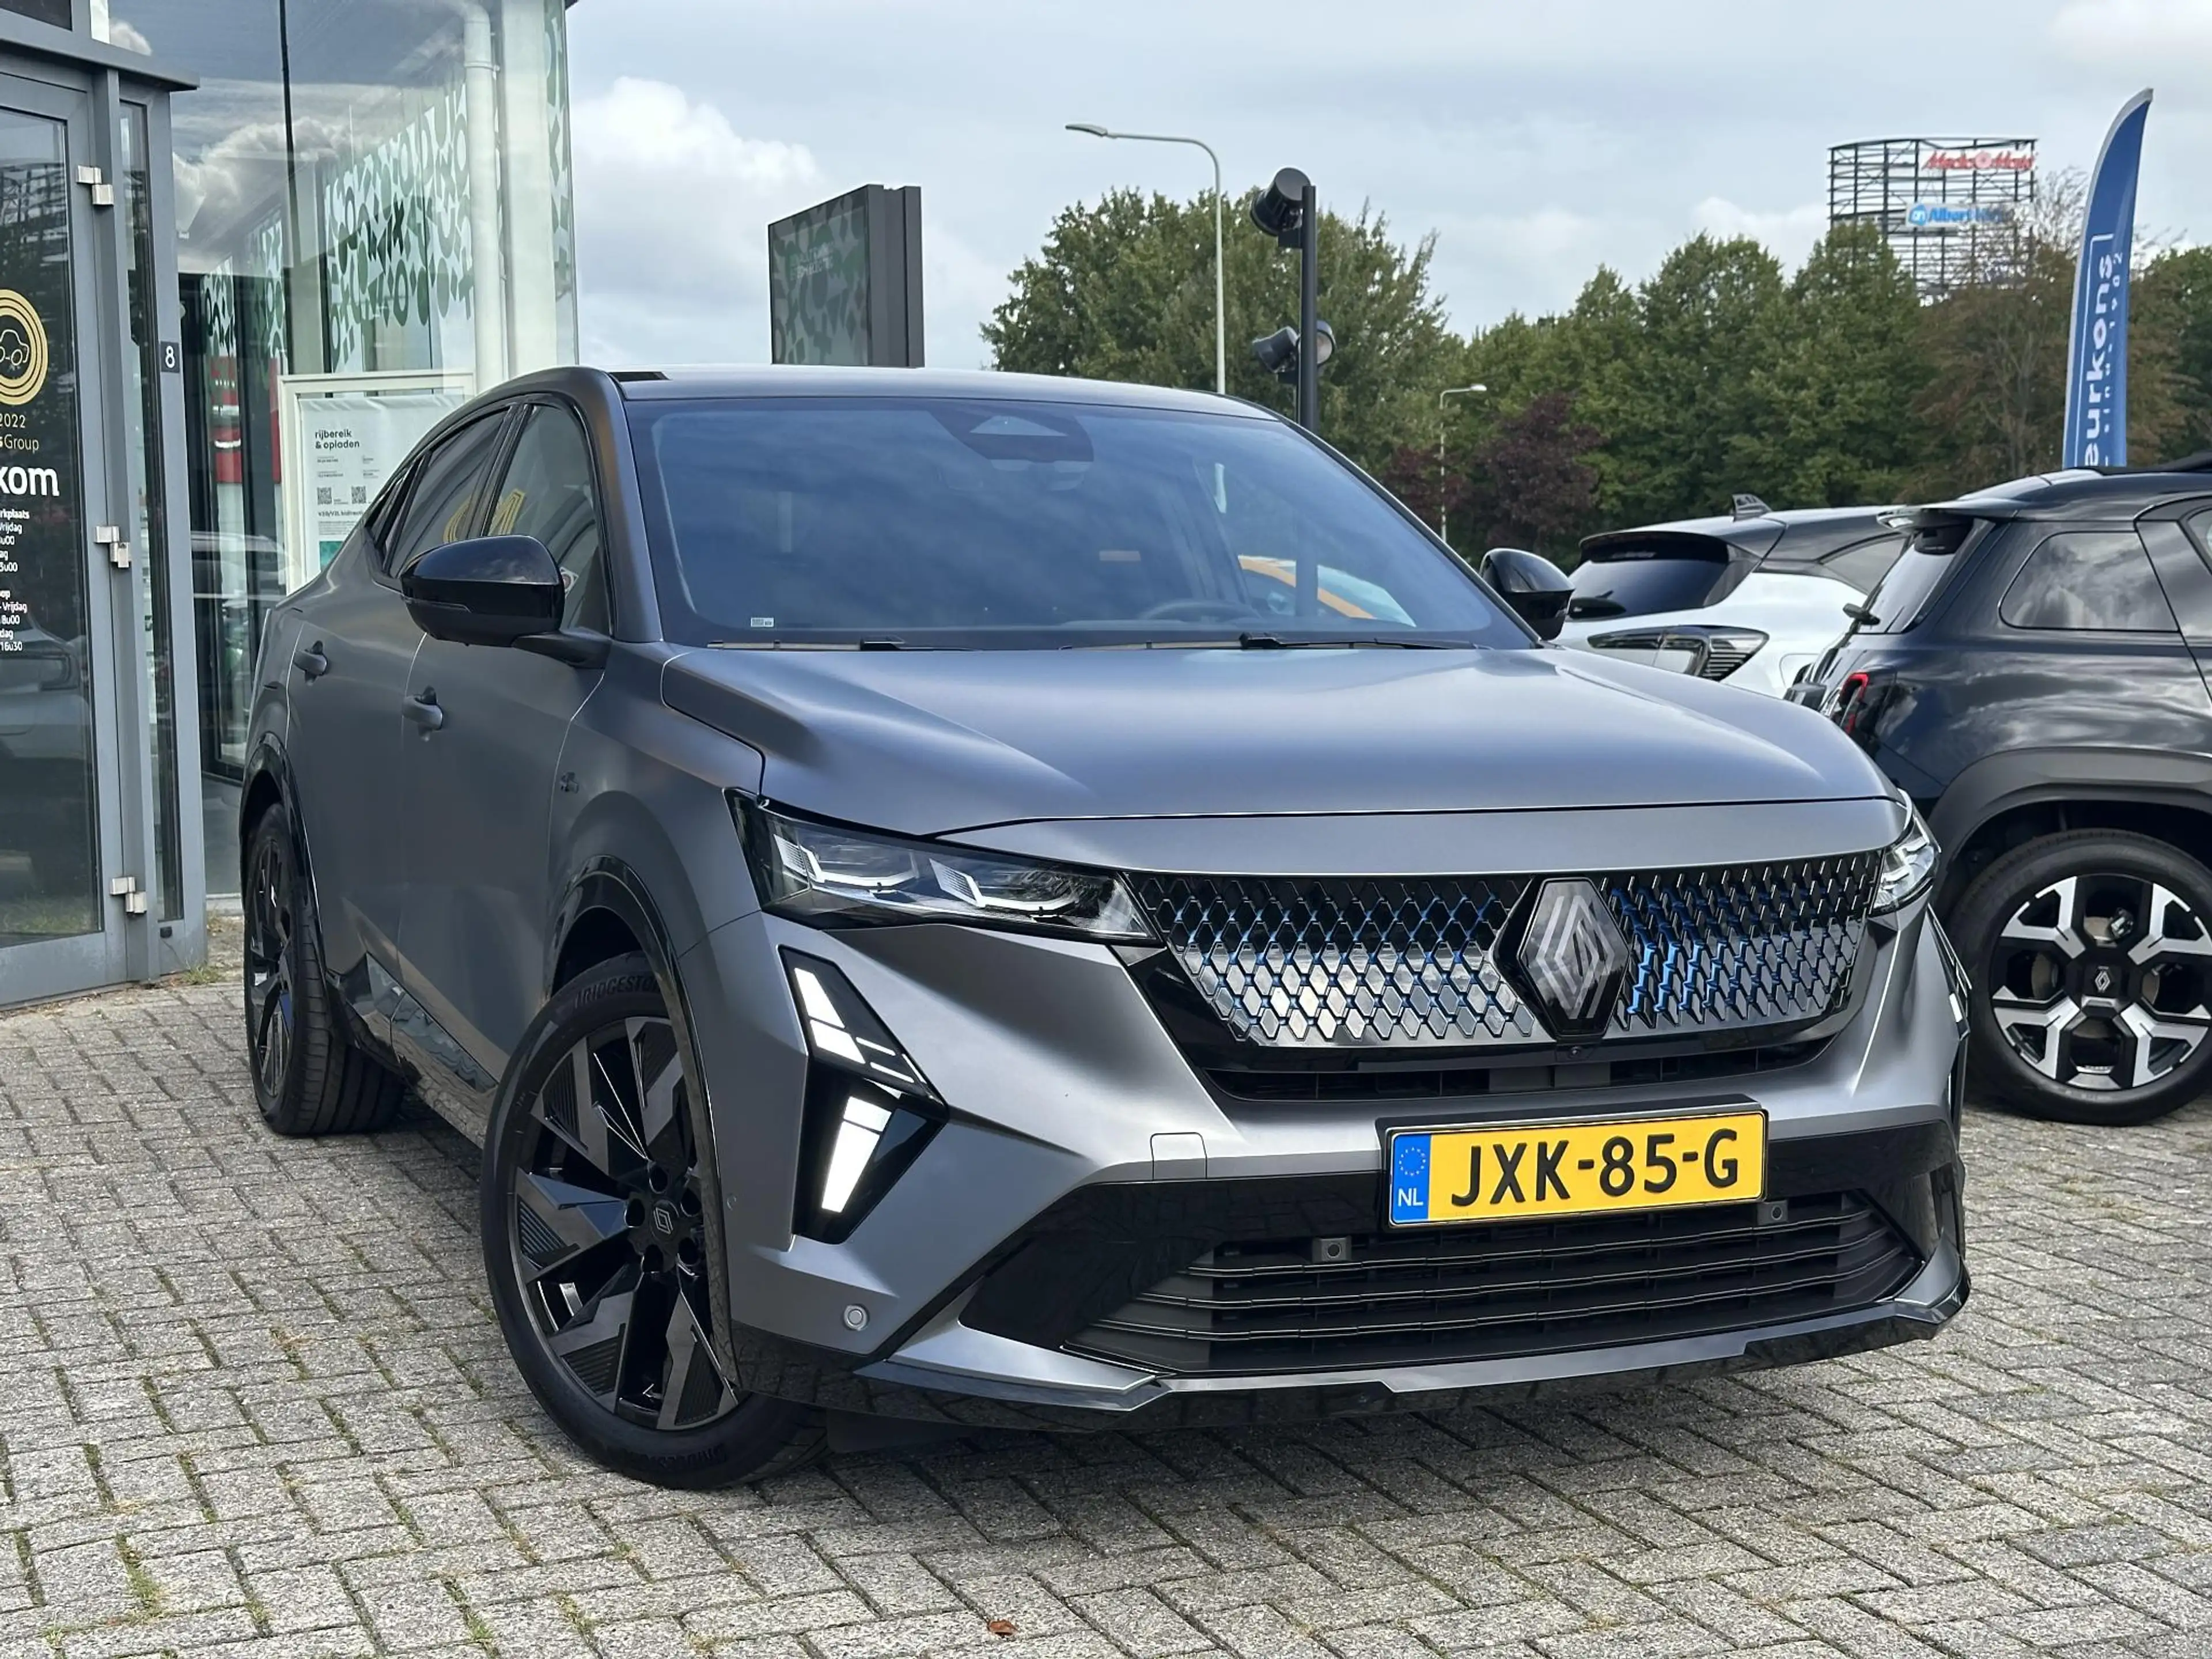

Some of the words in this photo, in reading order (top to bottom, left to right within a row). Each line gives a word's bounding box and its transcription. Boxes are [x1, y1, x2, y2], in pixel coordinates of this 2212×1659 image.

[165, 345, 175, 368] 8
[315, 429, 352, 440] rijbereik
[315, 441, 321, 449] &
[323, 440, 359, 451] opladen
[1451, 1128, 1738, 1207] JXK-85-G
[1397, 1187, 1423, 1207] NL
